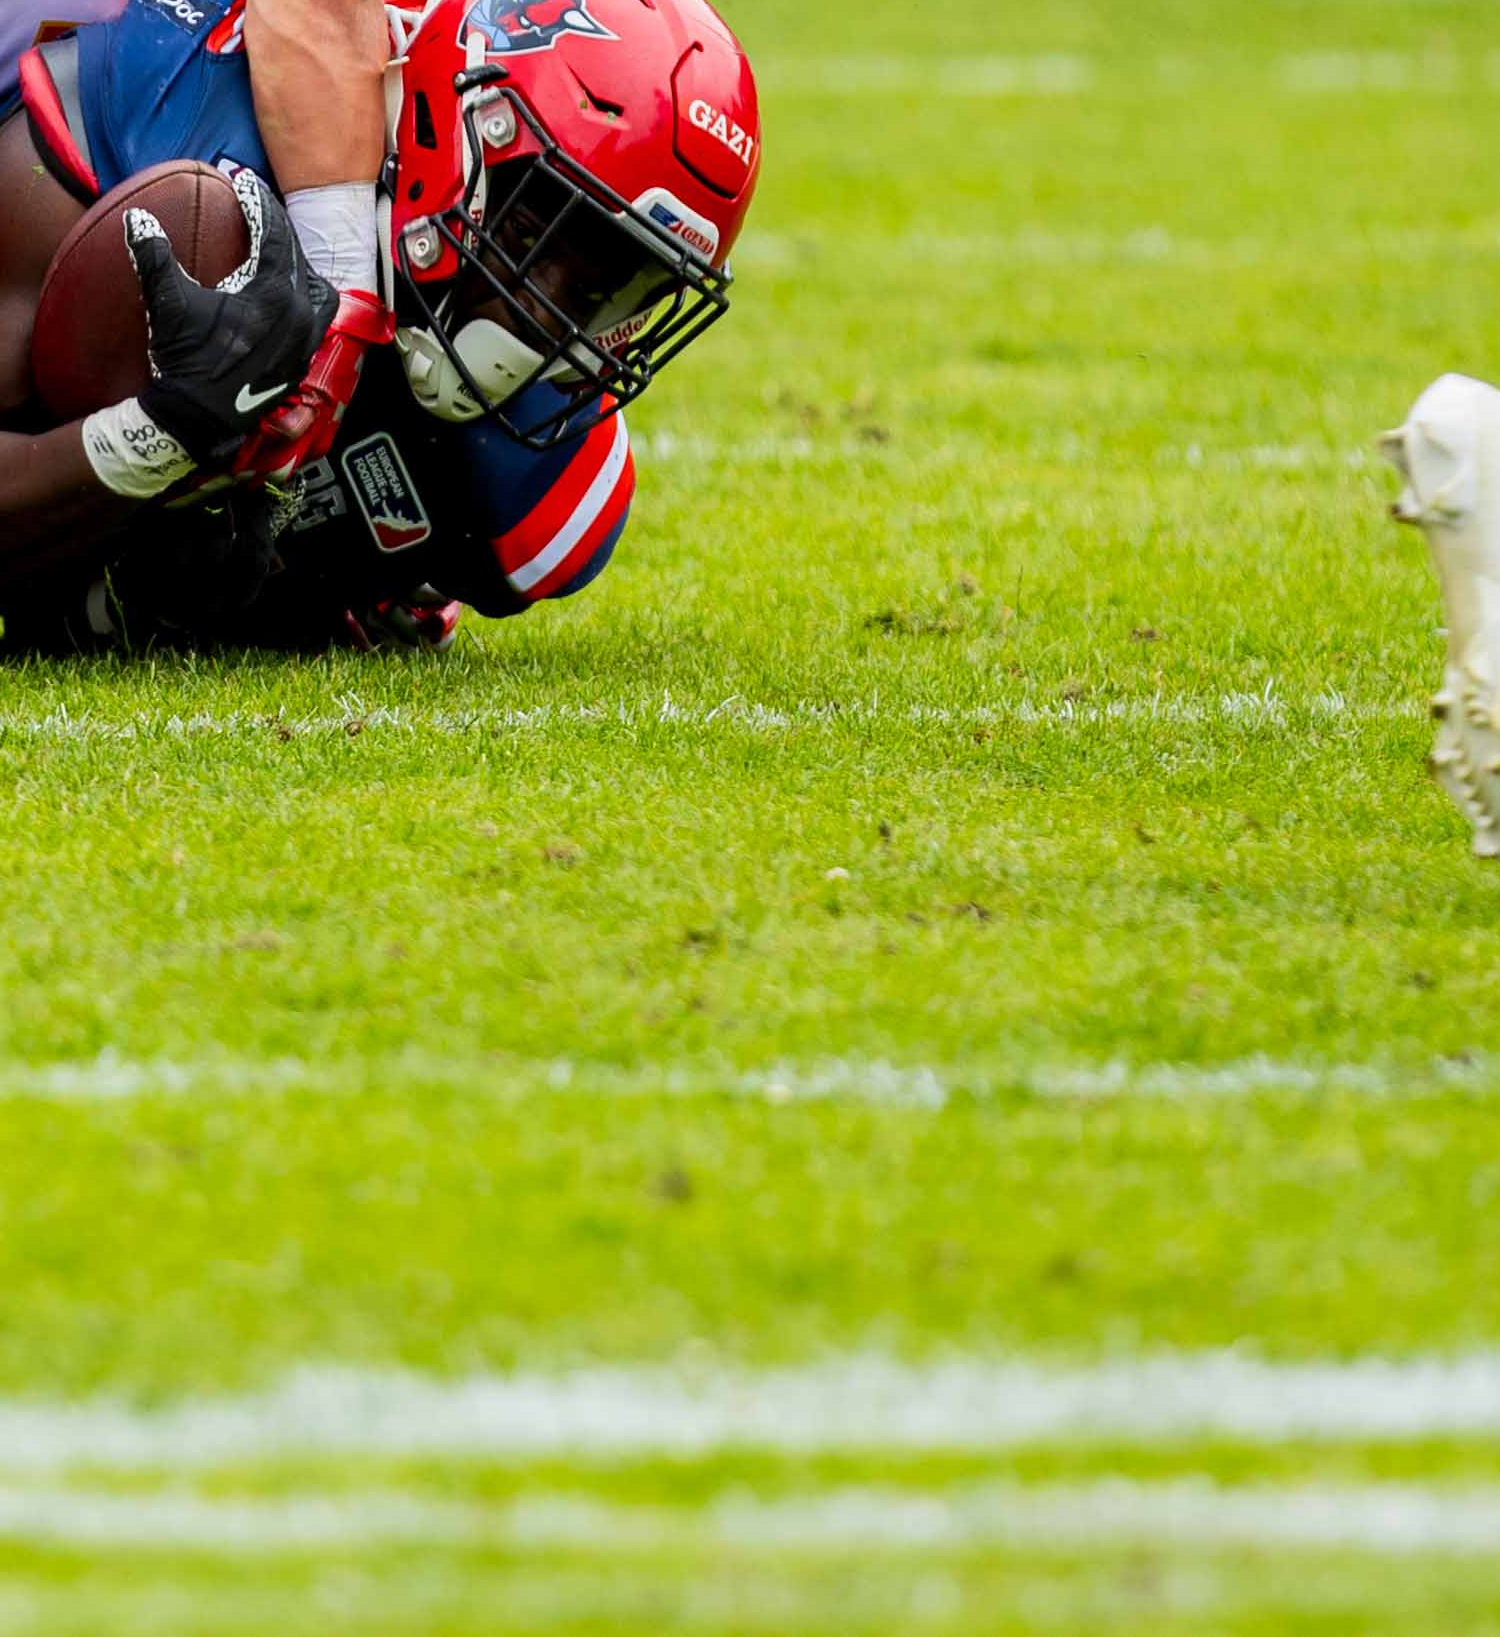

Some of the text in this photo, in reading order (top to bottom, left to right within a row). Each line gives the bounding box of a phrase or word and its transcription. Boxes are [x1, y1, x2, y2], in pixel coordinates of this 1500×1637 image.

[688, 99, 754, 166] GAZI
[353, 457, 381, 506] FOOTBALL
[364, 451, 388, 490] LEAGUE
[375, 445, 405, 499] EUROPEAN
